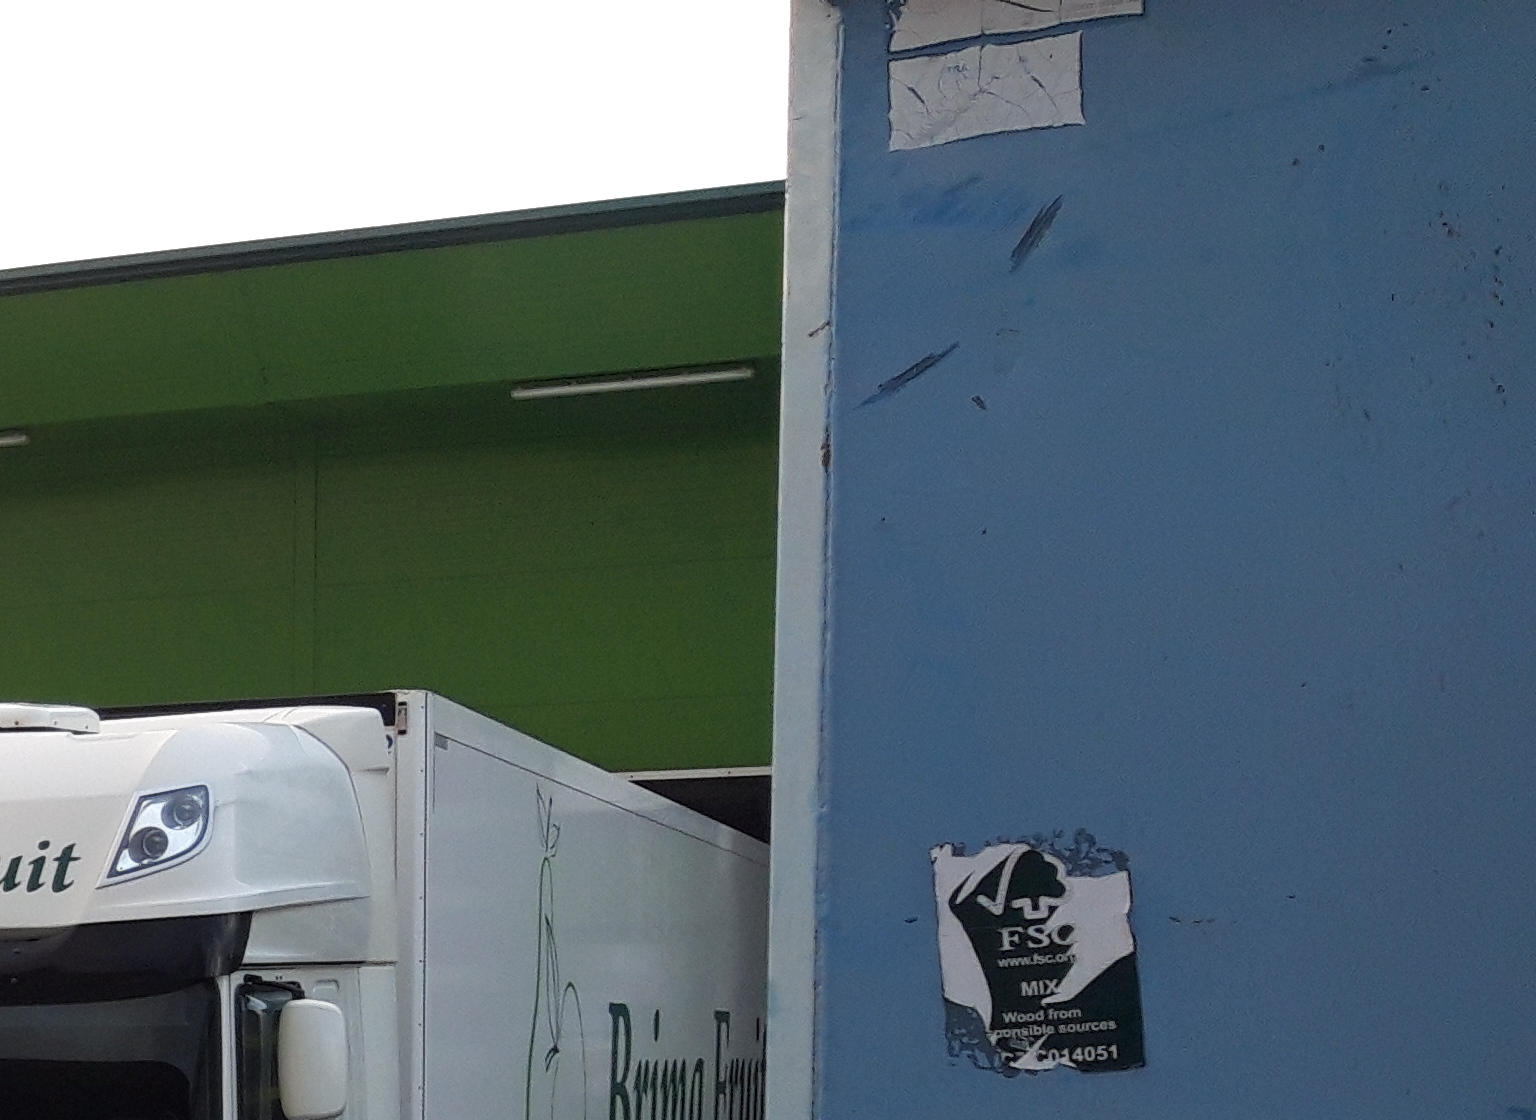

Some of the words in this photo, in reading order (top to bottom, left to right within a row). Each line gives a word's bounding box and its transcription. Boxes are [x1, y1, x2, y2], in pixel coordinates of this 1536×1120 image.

[998, 923, 1077, 951] FSC
[1021, 978, 1060, 997] MIX
[1002, 1010, 1044, 1024] Wood
[1048, 1009, 1082, 1021] from
[1058, 1019, 1117, 1032] sources
